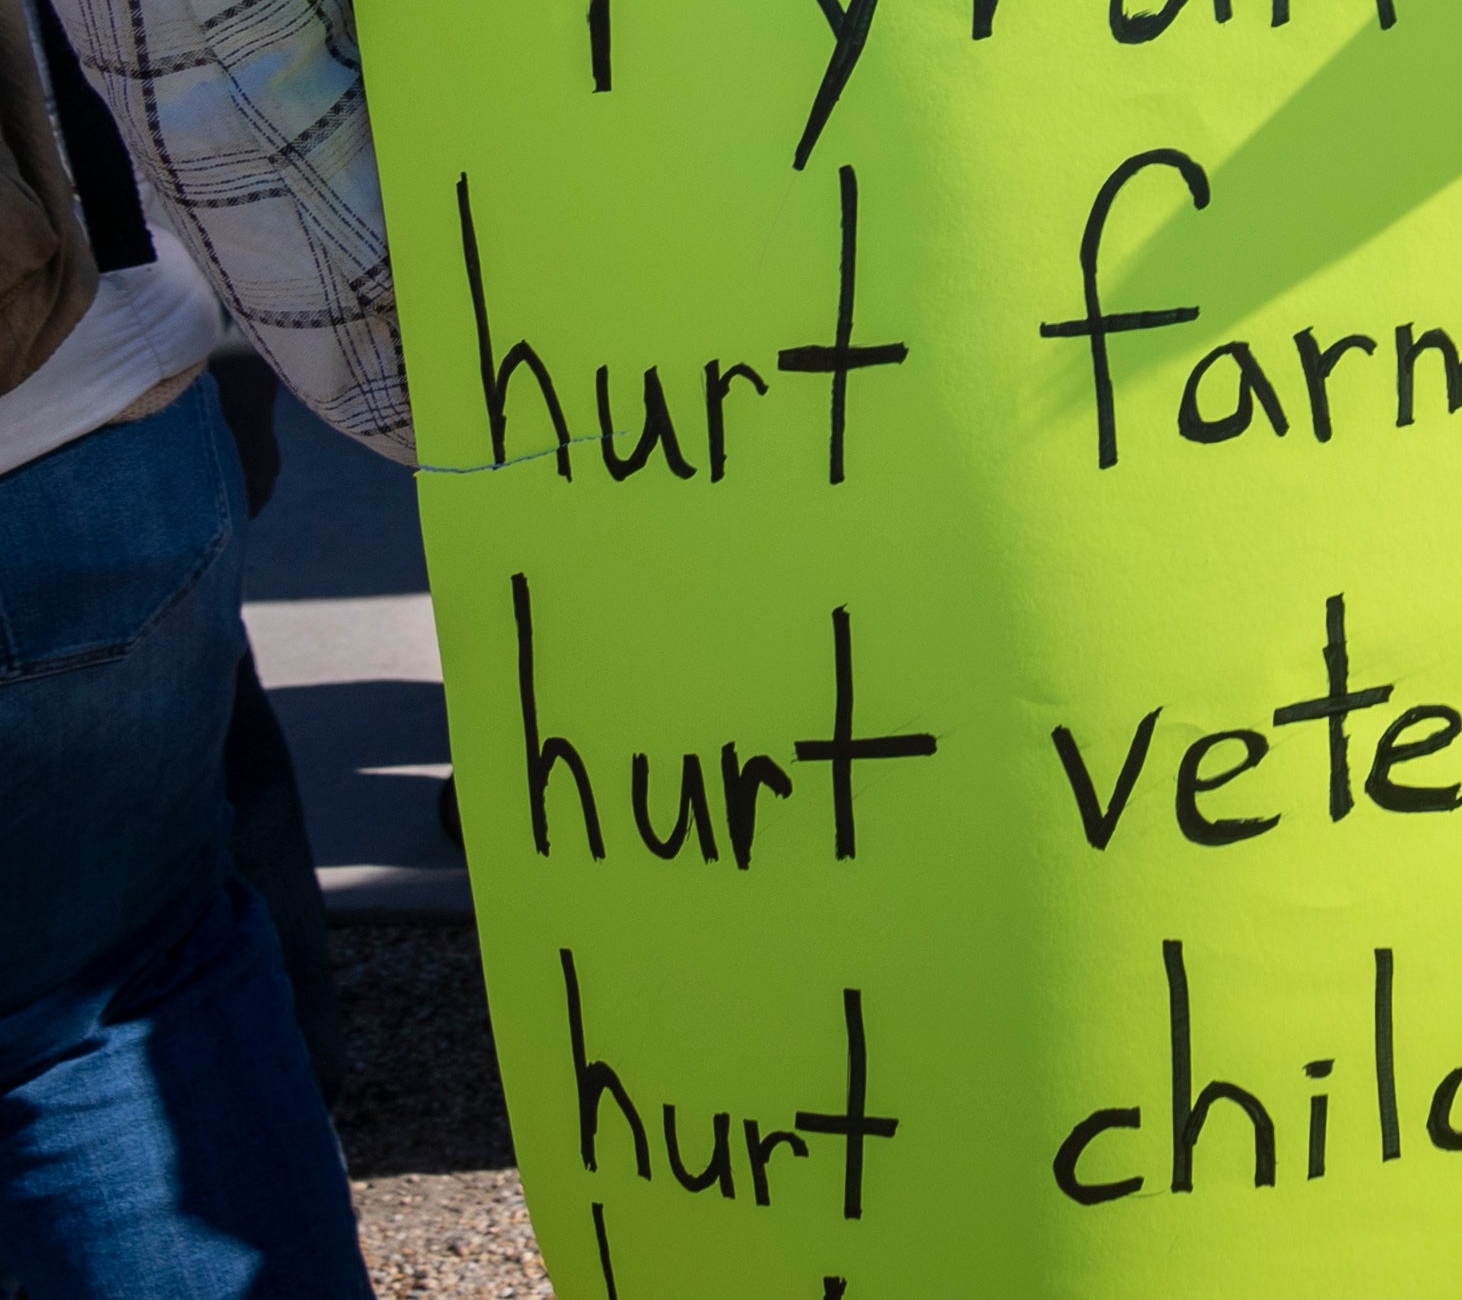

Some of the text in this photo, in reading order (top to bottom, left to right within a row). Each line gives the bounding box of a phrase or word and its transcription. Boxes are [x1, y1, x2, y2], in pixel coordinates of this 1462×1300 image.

[456, 165, 909, 486] hurt
[510, 572, 939, 872] hurt
[559, 948, 900, 1221] hurt
